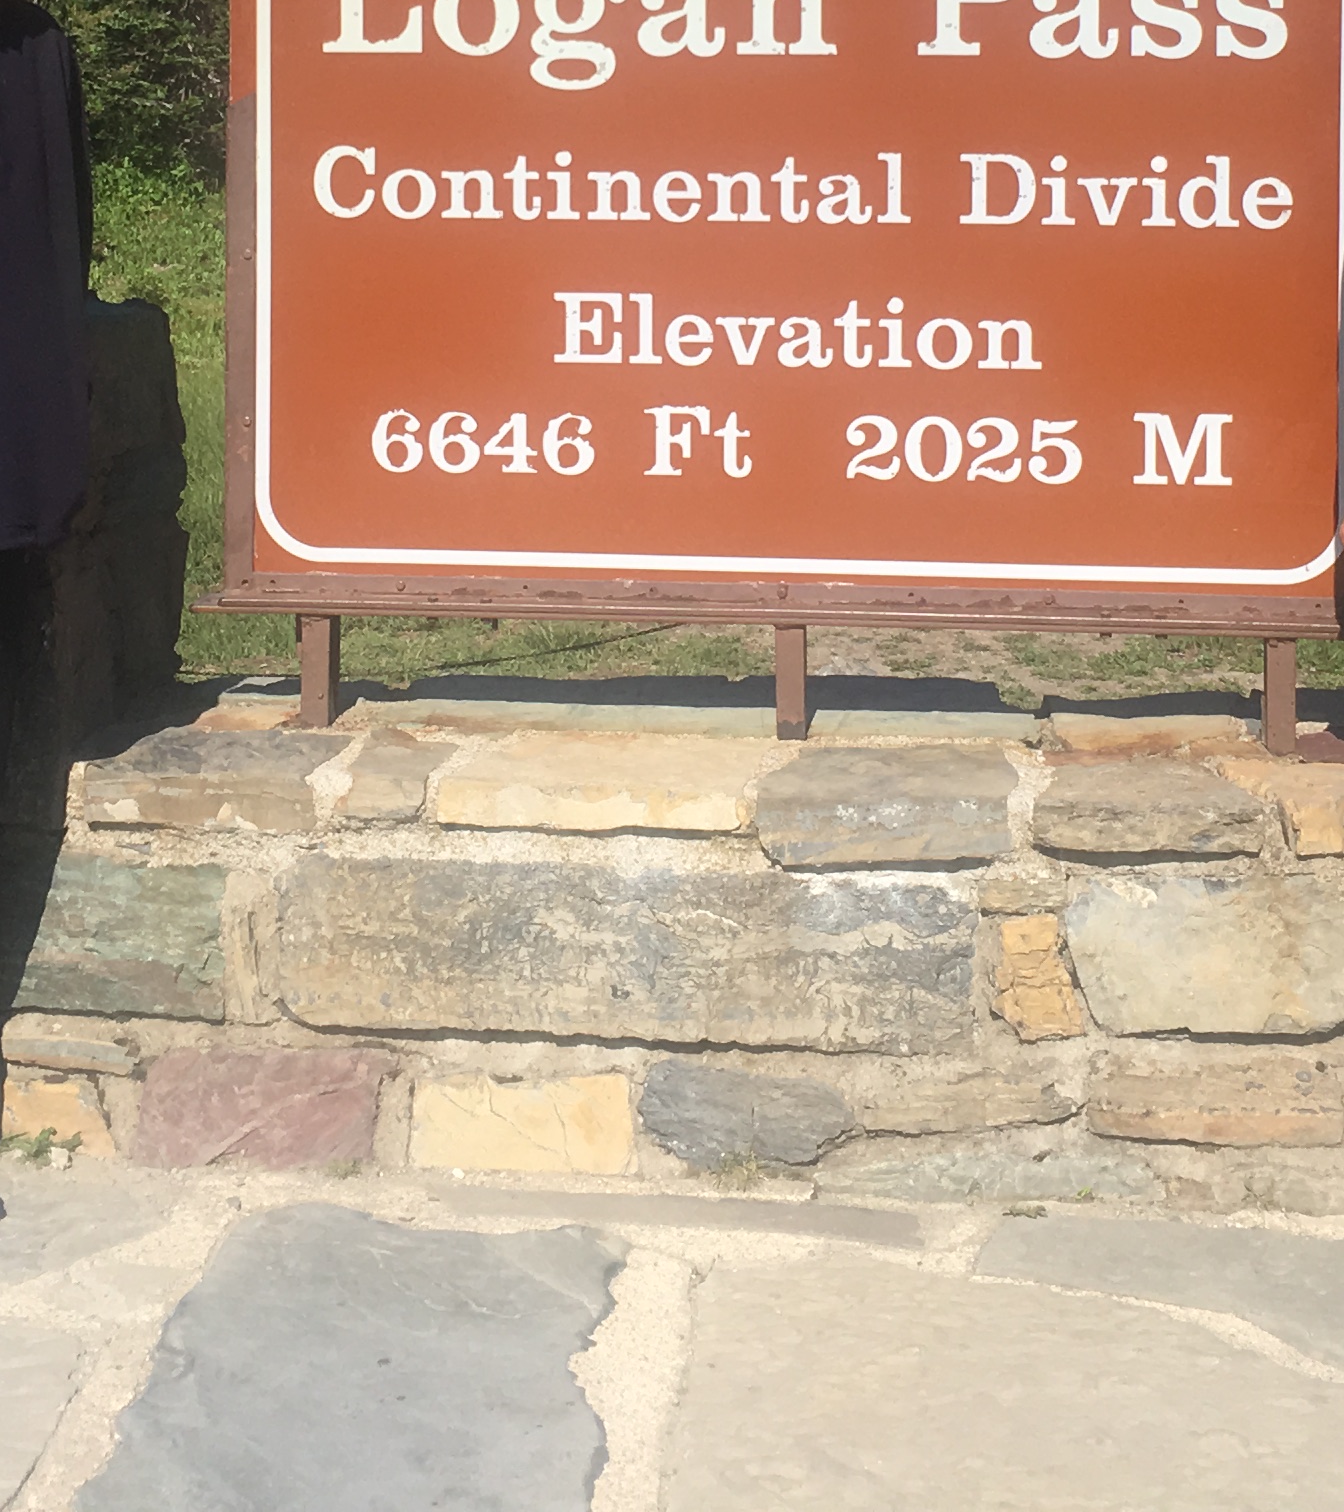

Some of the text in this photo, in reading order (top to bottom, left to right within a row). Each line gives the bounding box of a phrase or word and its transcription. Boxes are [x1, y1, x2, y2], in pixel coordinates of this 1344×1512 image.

[313, 145, 1294, 231] Continental Divide
[553, 291, 1044, 371] Elevation
[371, 404, 1234, 487] 6646 Ft 2025 M
